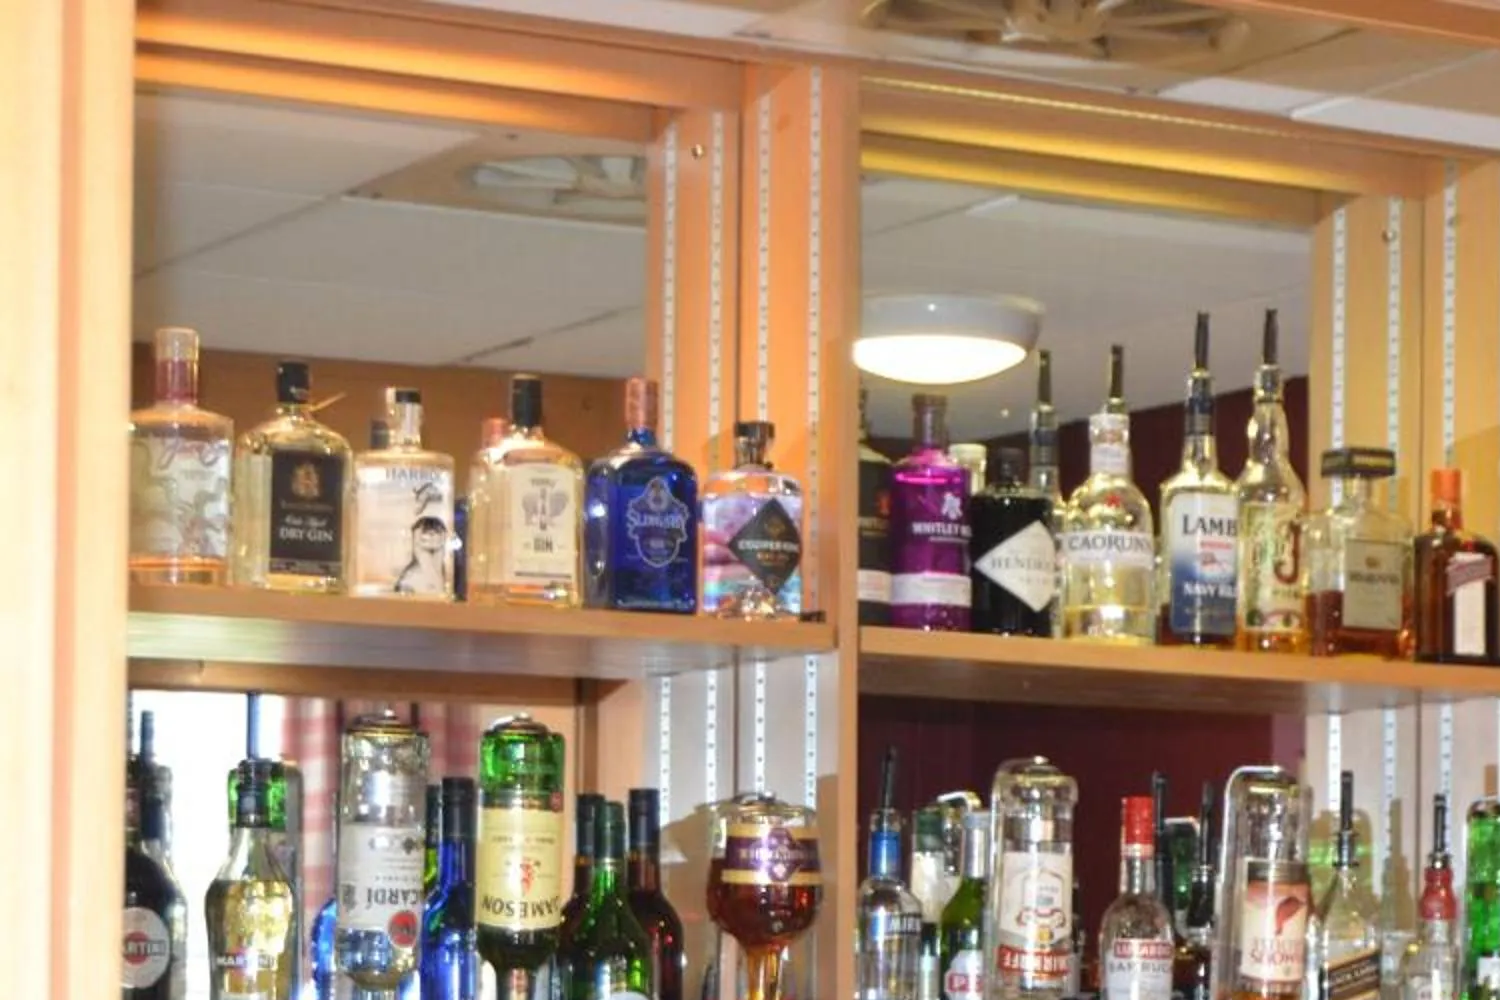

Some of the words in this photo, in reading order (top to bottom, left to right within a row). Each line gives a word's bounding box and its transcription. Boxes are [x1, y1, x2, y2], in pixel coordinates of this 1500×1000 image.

[307, 528, 333, 542] GIN
[1182, 514, 1238, 537] LAMB
[481, 895, 559, 918] JAMESON
